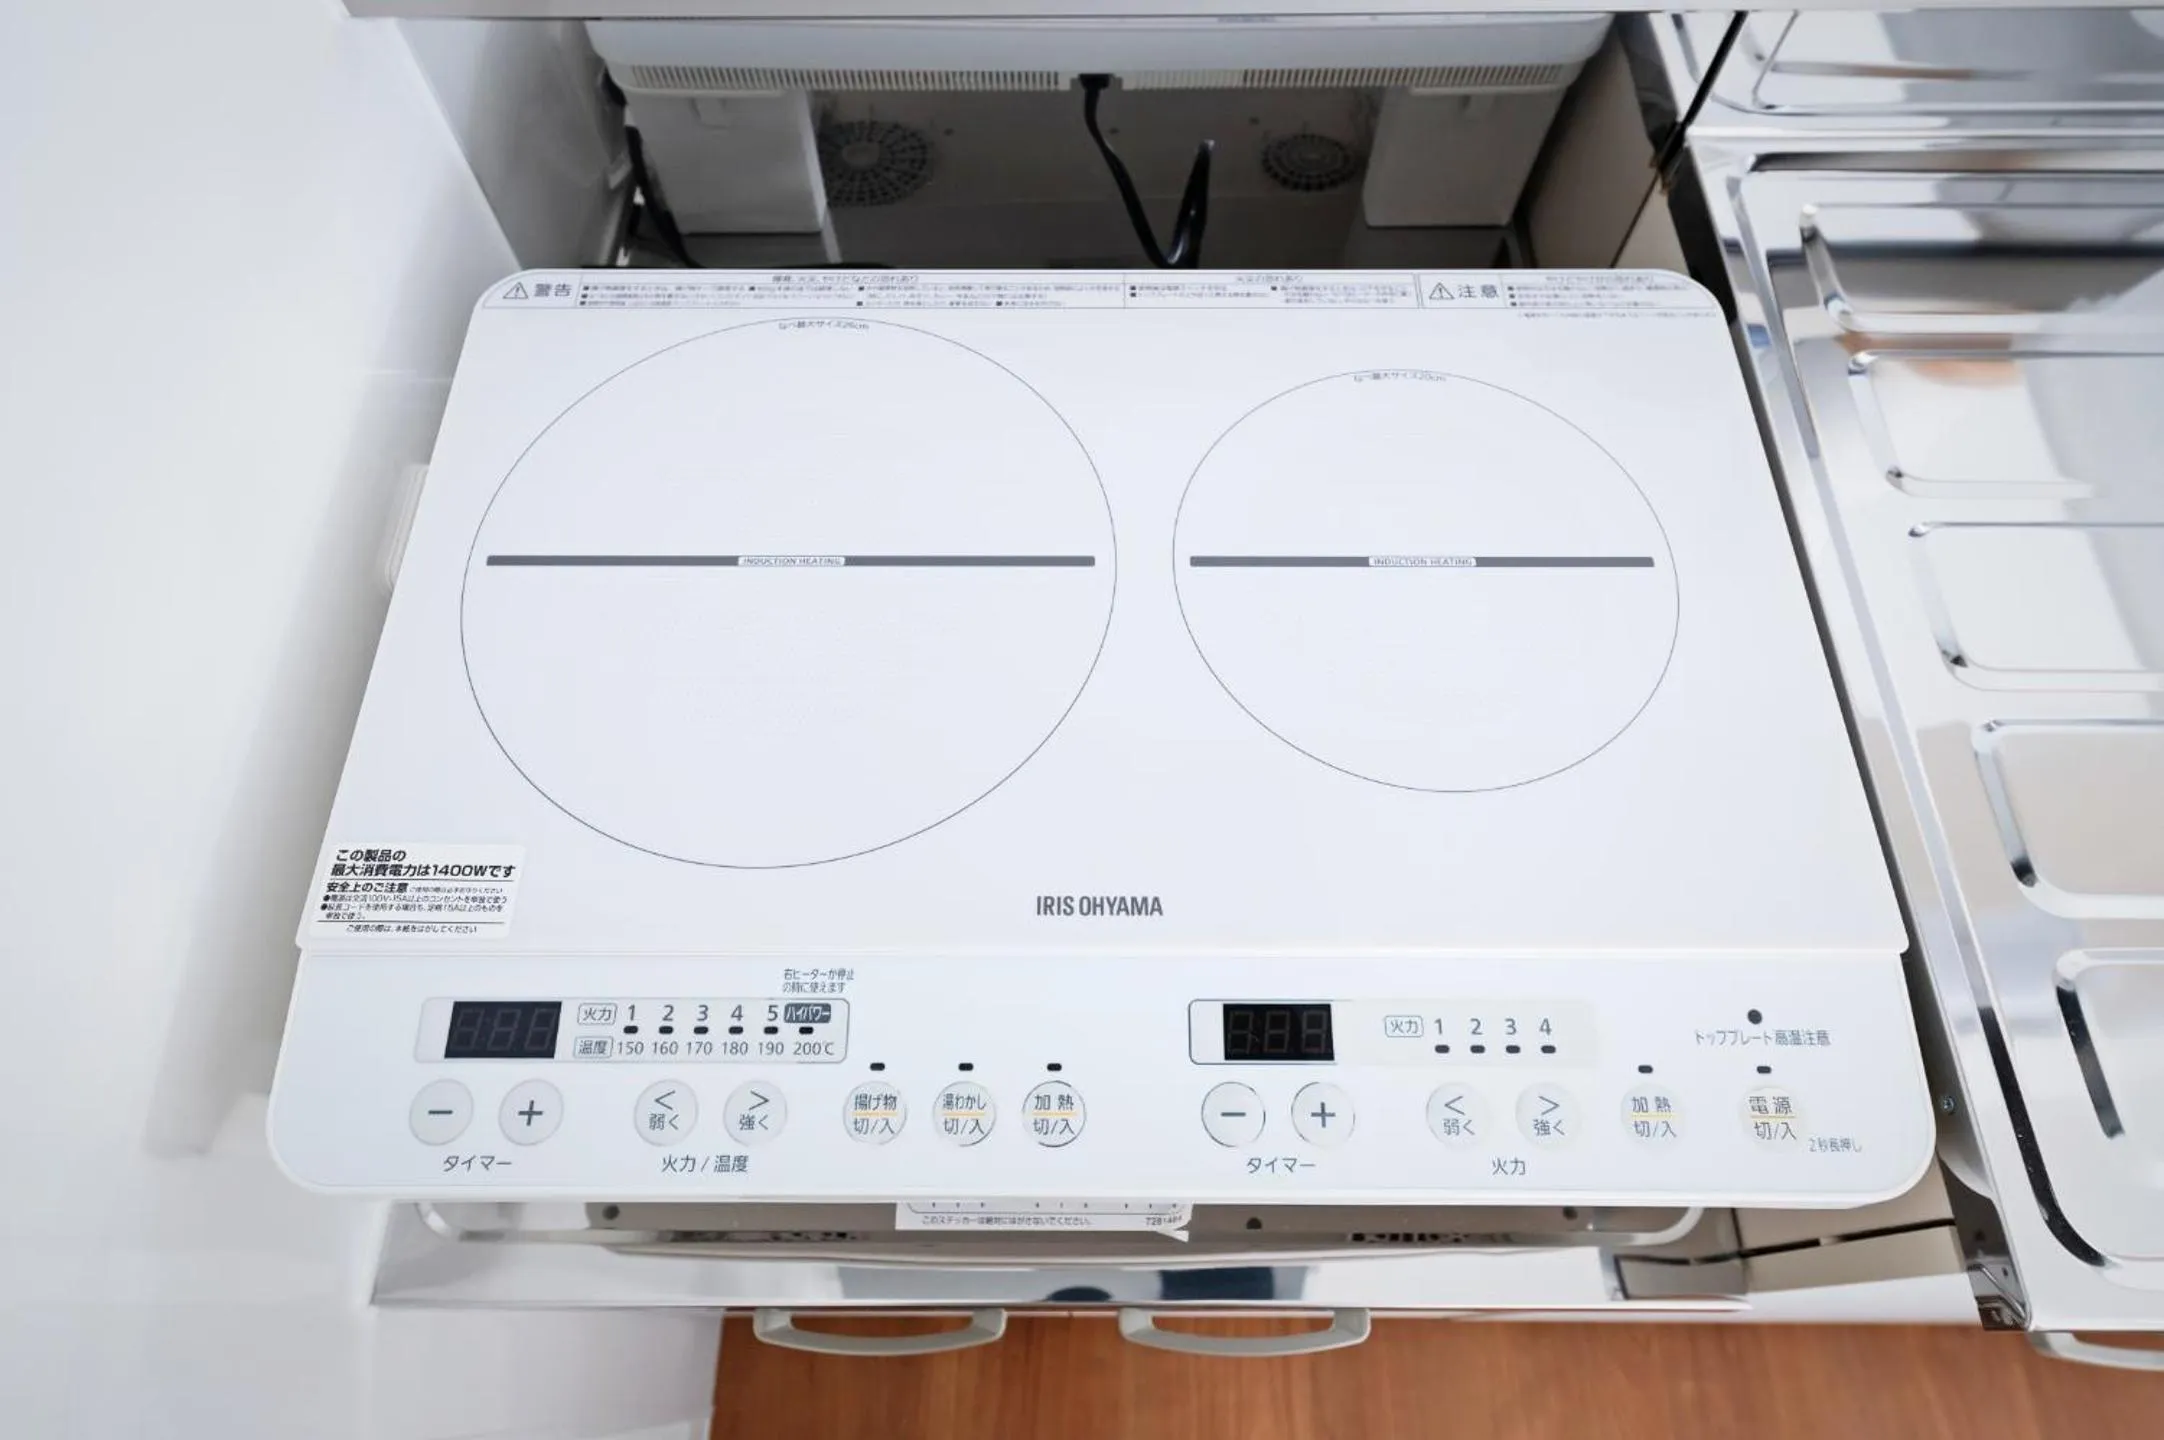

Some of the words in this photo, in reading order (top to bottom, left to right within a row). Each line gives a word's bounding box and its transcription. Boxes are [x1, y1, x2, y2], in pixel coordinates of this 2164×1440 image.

[534, 283, 573, 298] 警告
[1458, 284, 1499, 299] 注意
[336, 849, 407, 862] この製品の
[330, 863, 516, 878] 最大消費電力は1400Wです
[326, 882, 409, 893] 安全上のご注意
[1036, 895, 1075, 916] IRIS
[1079, 895, 1164, 916] OHYAMA
[783, 981, 846, 994] の時に使えます
[583, 1007, 612, 1023] 火力
[628, 1004, 636, 1021] 1
[662, 1004, 675, 1021] 2
[697, 1004, 709, 1021] 3
[730, 1004, 744, 1021] 4
[767, 1004, 778, 1021] 5
[1390, 1019, 1419, 1035] 火力
[1434, 1018, 1442, 1035] 1
[1470, 1018, 1483, 1035] 2
[1506, 1018, 1517, 1035] 3
[1539, 1018, 1552, 1035] 4
[578, 1039, 608, 1056] 温度
[618, 1041, 644, 1055] 150
[652, 1041, 679, 1055] 160
[686, 1041, 713, 1055] 170
[722, 1041, 748, 1055] 180
[758, 1041, 784, 1055] 190
[854, 1093, 897, 1112] 揚げ物
[942, 1093, 986, 1111] 湯わかし
[1033, 1093, 1075, 1112] 加熱
[1632, 1095, 1672, 1113] 加熱
[1749, 1095, 1793, 1115] 電源
[649, 1113, 680, 1131] 弱く
[739, 1113, 770, 1131] 強く
[853, 1117, 895, 1136] 切/入
[944, 1117, 985, 1136] 切/入
[1033, 1117, 1075, 1136] 切/入
[1443, 1118, 1476, 1137] 弱く
[1534, 1118, 1566, 1137] 強く
[1633, 1120, 1678, 1139] 切/入
[1754, 1121, 1797, 1141] 切/入
[442, 1155, 513, 1172] タイマー
[1246, 1157, 1316, 1175] タイマー
[1492, 1157, 1526, 1176] 火力
